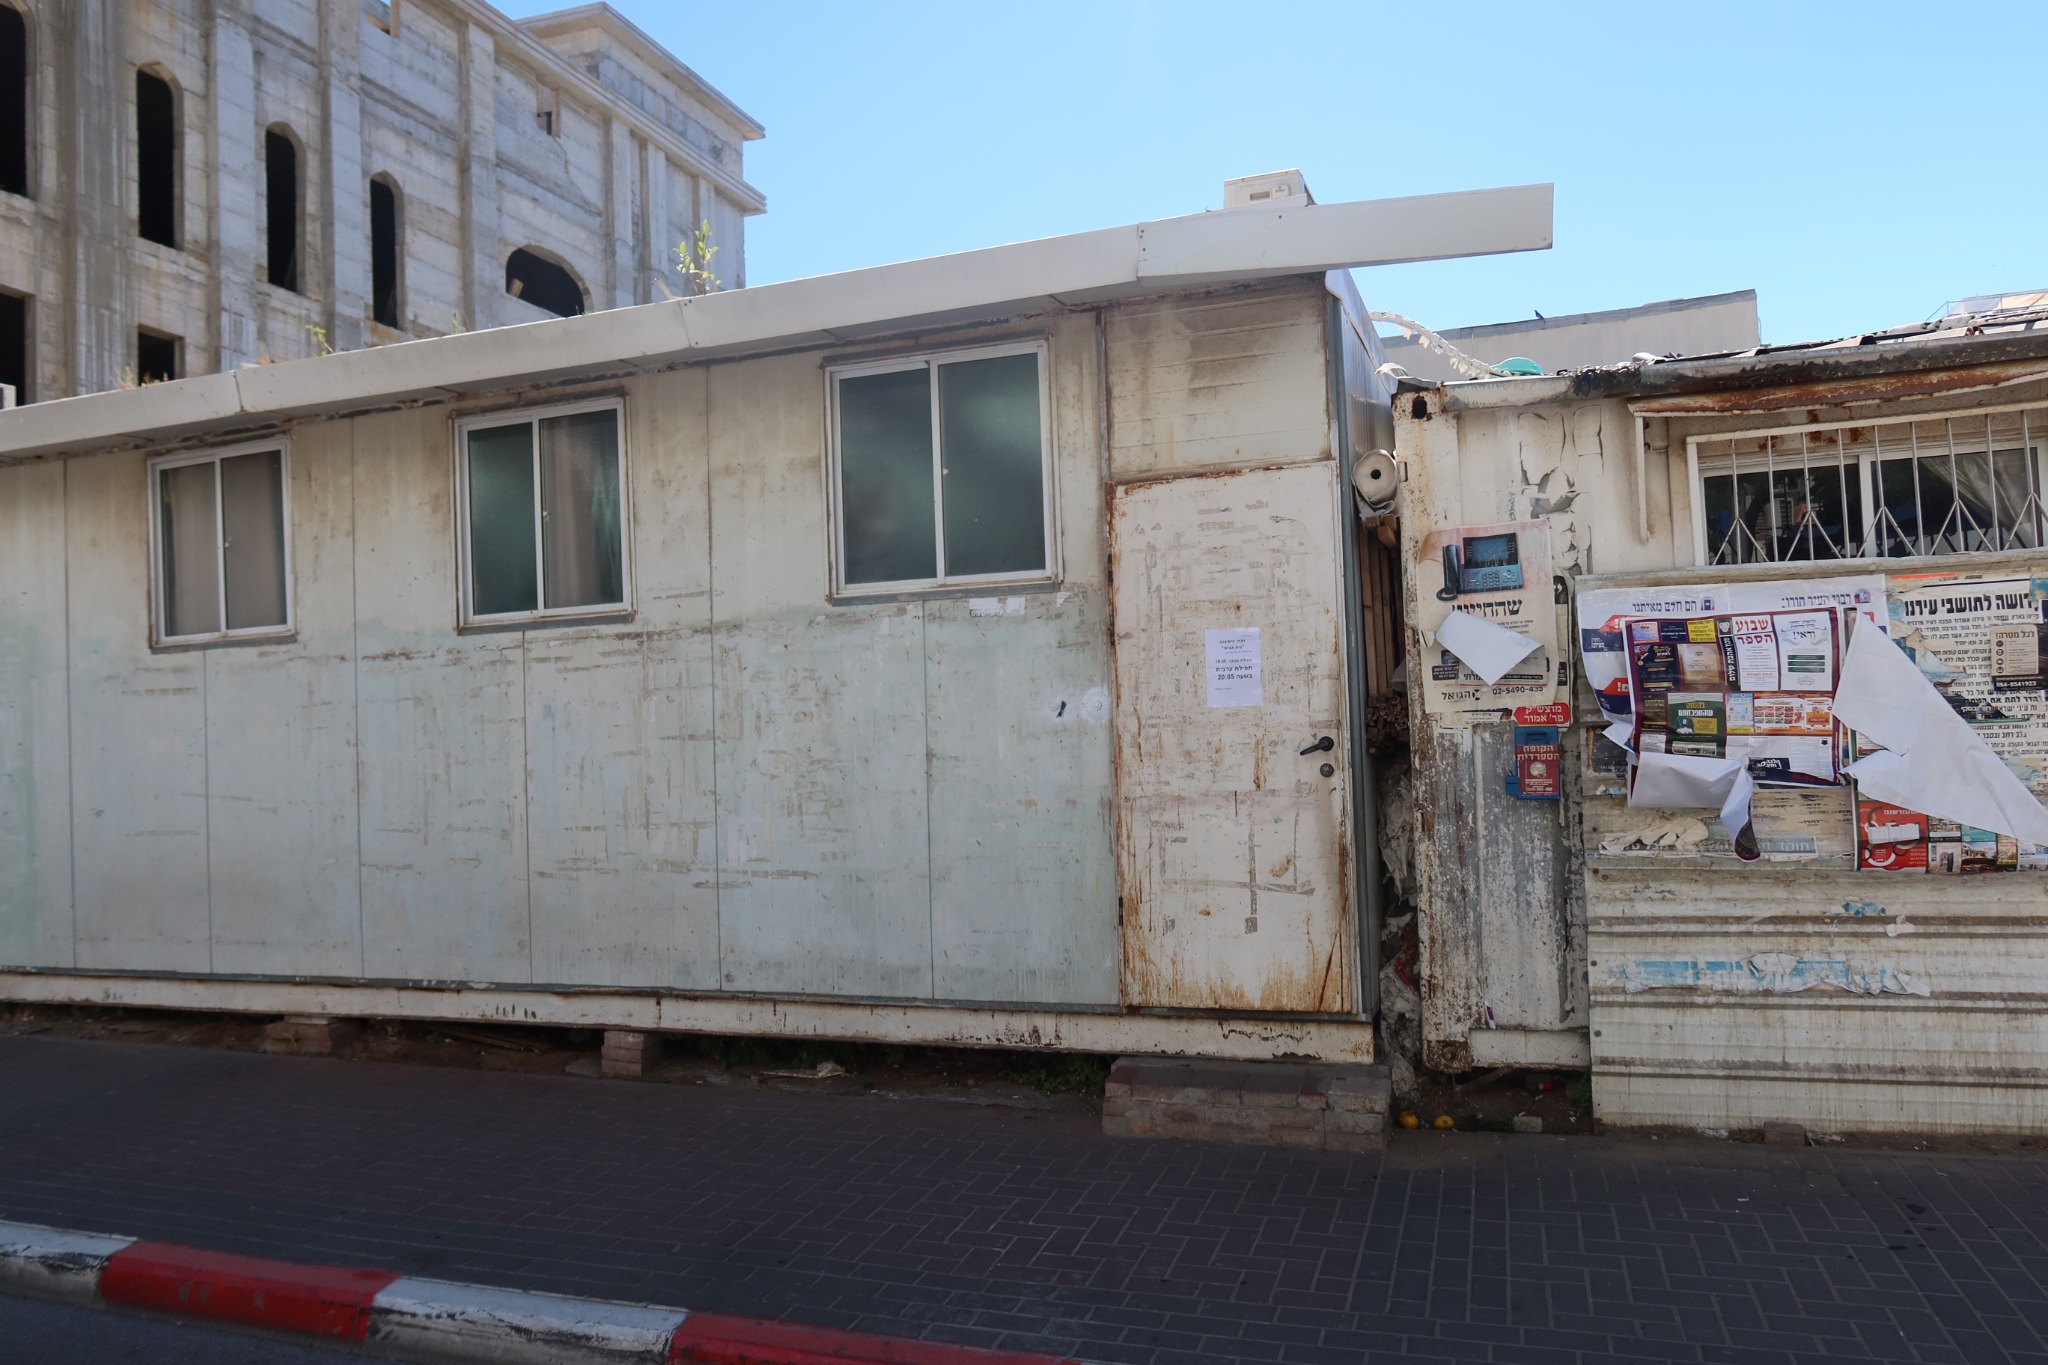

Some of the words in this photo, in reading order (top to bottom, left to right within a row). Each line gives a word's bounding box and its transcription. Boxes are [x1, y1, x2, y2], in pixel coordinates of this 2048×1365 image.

[1832, 593, 1851, 605] רבני
[1941, 594, 1992, 614] לתושבי
[1632, 602, 1663, 613] מאיתנו
[1664, 600, 1682, 612] חלק
[1905, 599, 1938, 616] עירנו
[1735, 618, 1769, 633] שבוע
[1737, 633, 1774, 645] הספר
[1995, 631, 2019, 640] מטרה!
[2019, 630, 2036, 638] לכל
[1441, 691, 1471, 700] הגואל
[1523, 745, 1554, 753] הקופה
[1516, 753, 1560, 761] הספרדית
